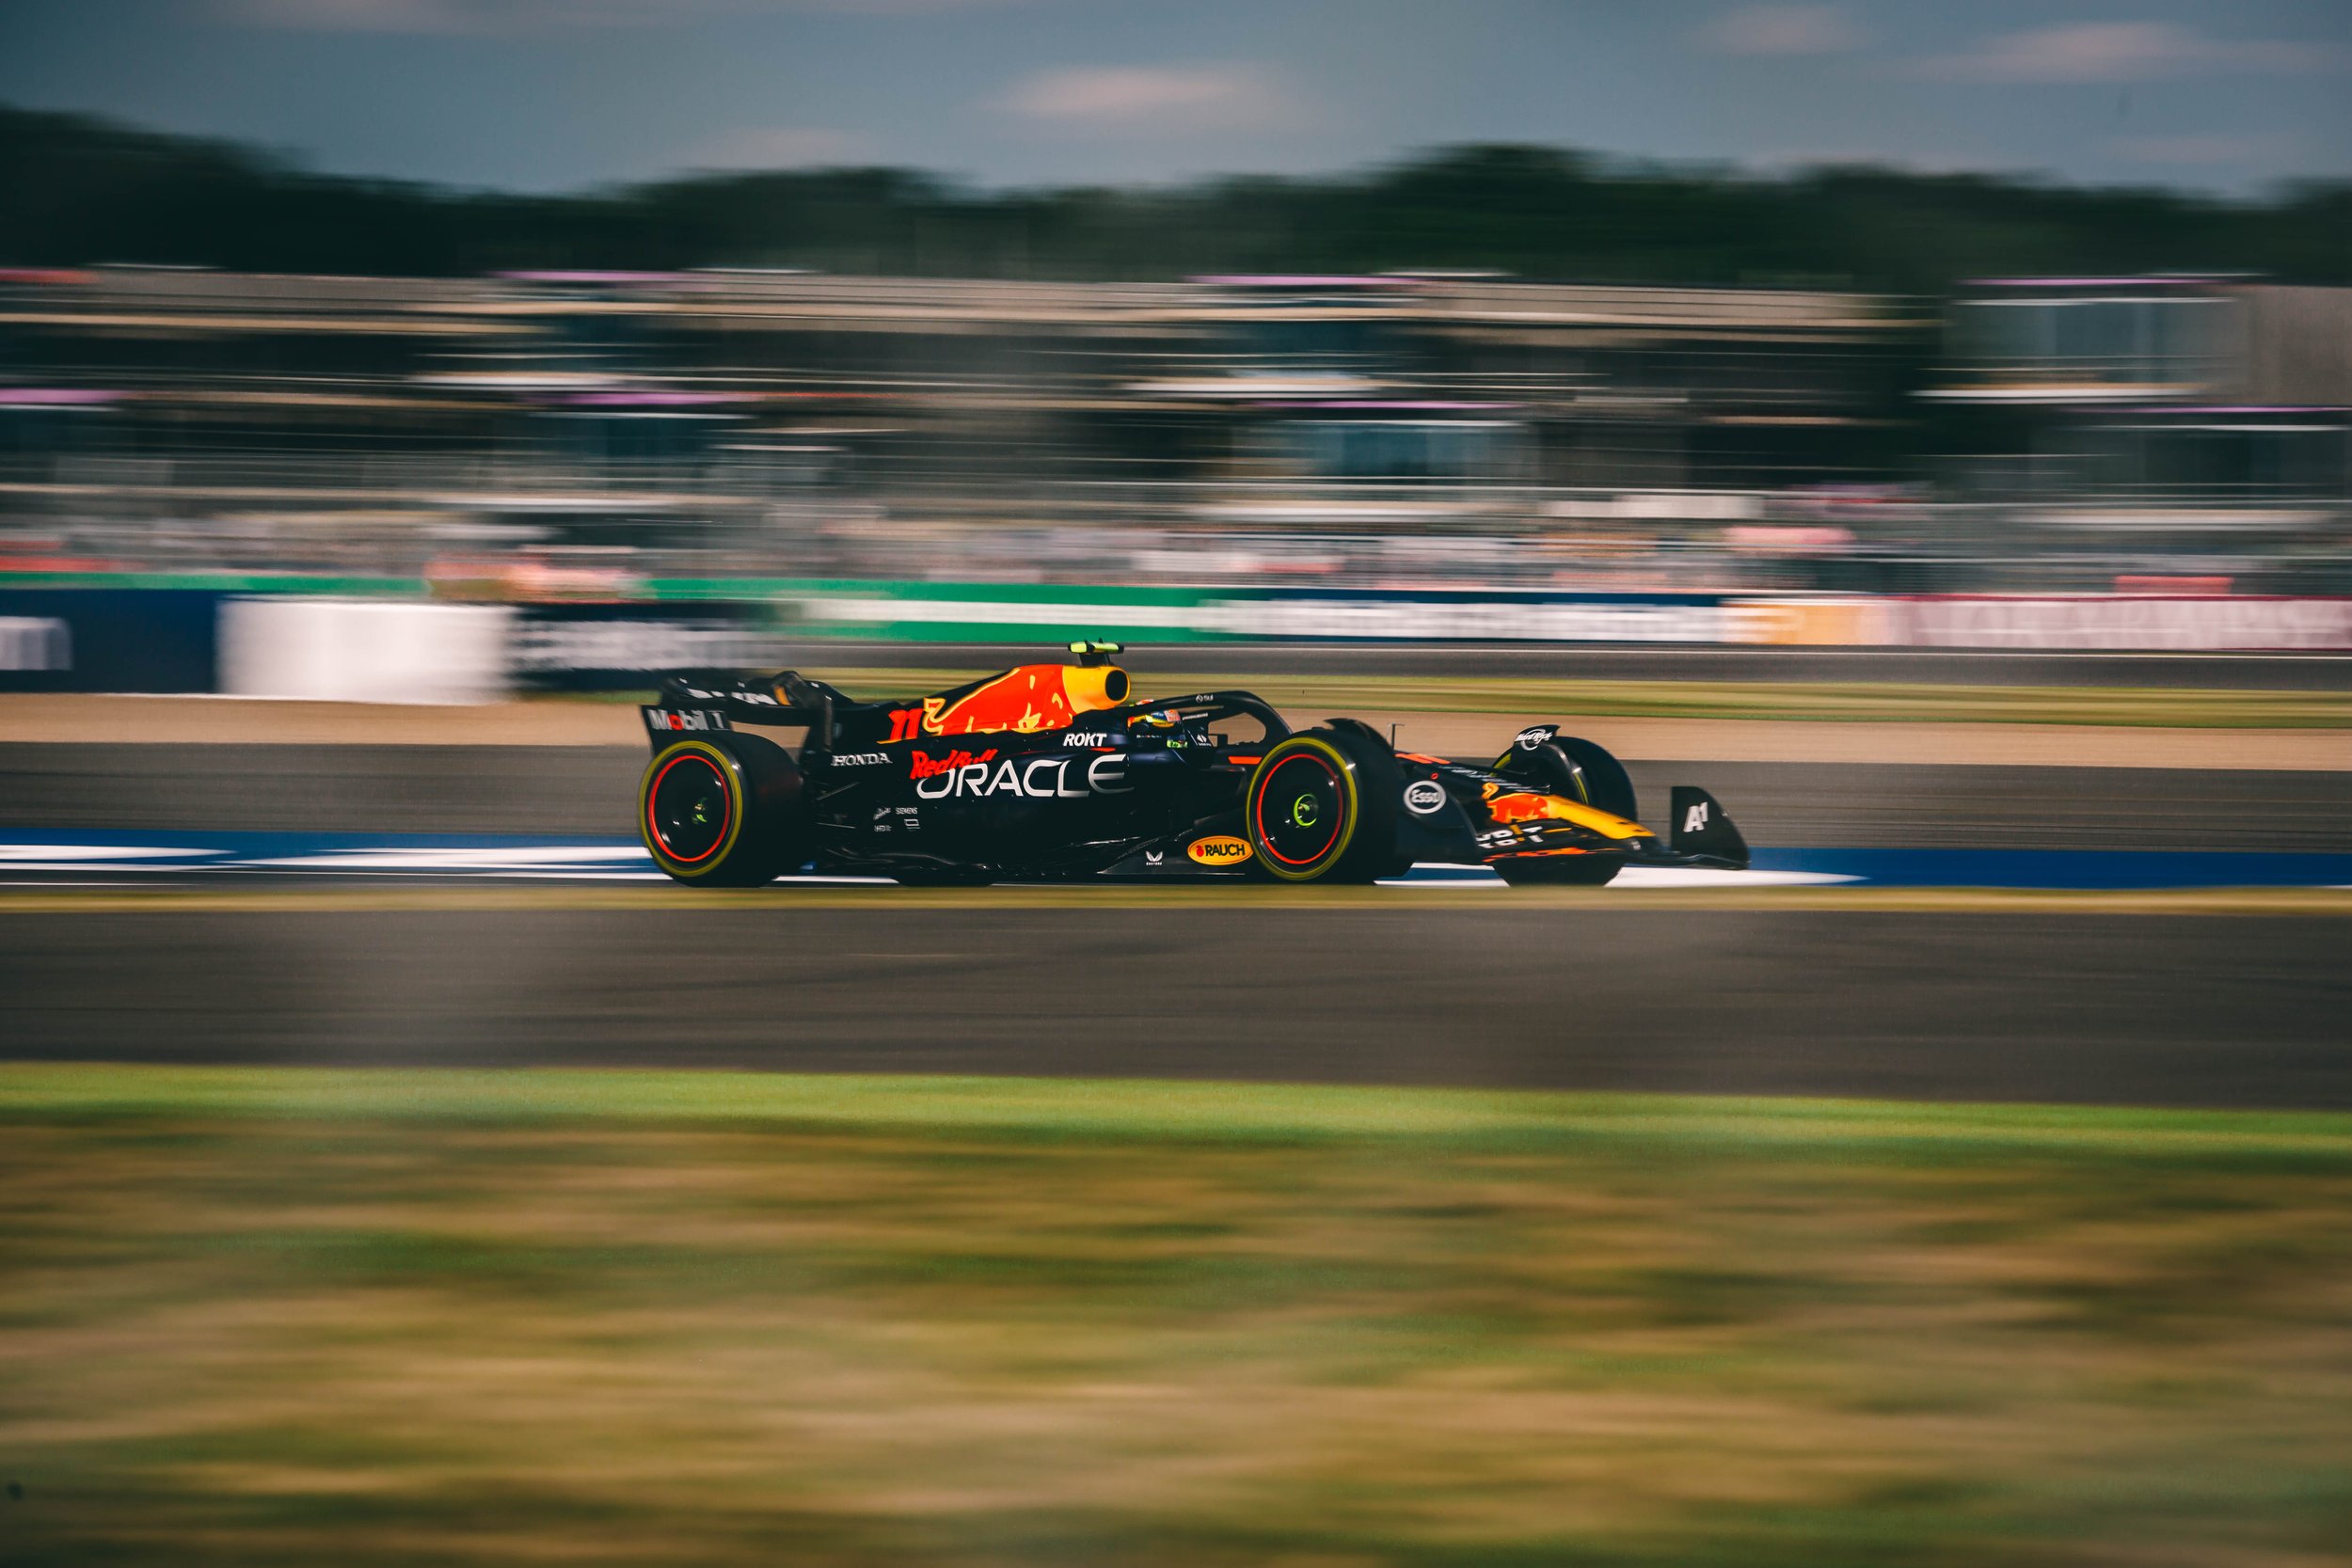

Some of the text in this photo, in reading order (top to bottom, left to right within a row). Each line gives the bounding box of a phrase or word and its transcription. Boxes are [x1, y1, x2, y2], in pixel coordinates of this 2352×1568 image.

[646, 709, 709, 731] Mobil
[888, 707, 923, 740] 11
[1063, 734, 1107, 747] ROKT
[831, 752, 893, 766] HONDA
[910, 750, 958, 779] Red
[915, 753, 1135, 800] ORACLE
[1683, 801, 1708, 832] A1
[1205, 844, 1246, 857] RAUCH
